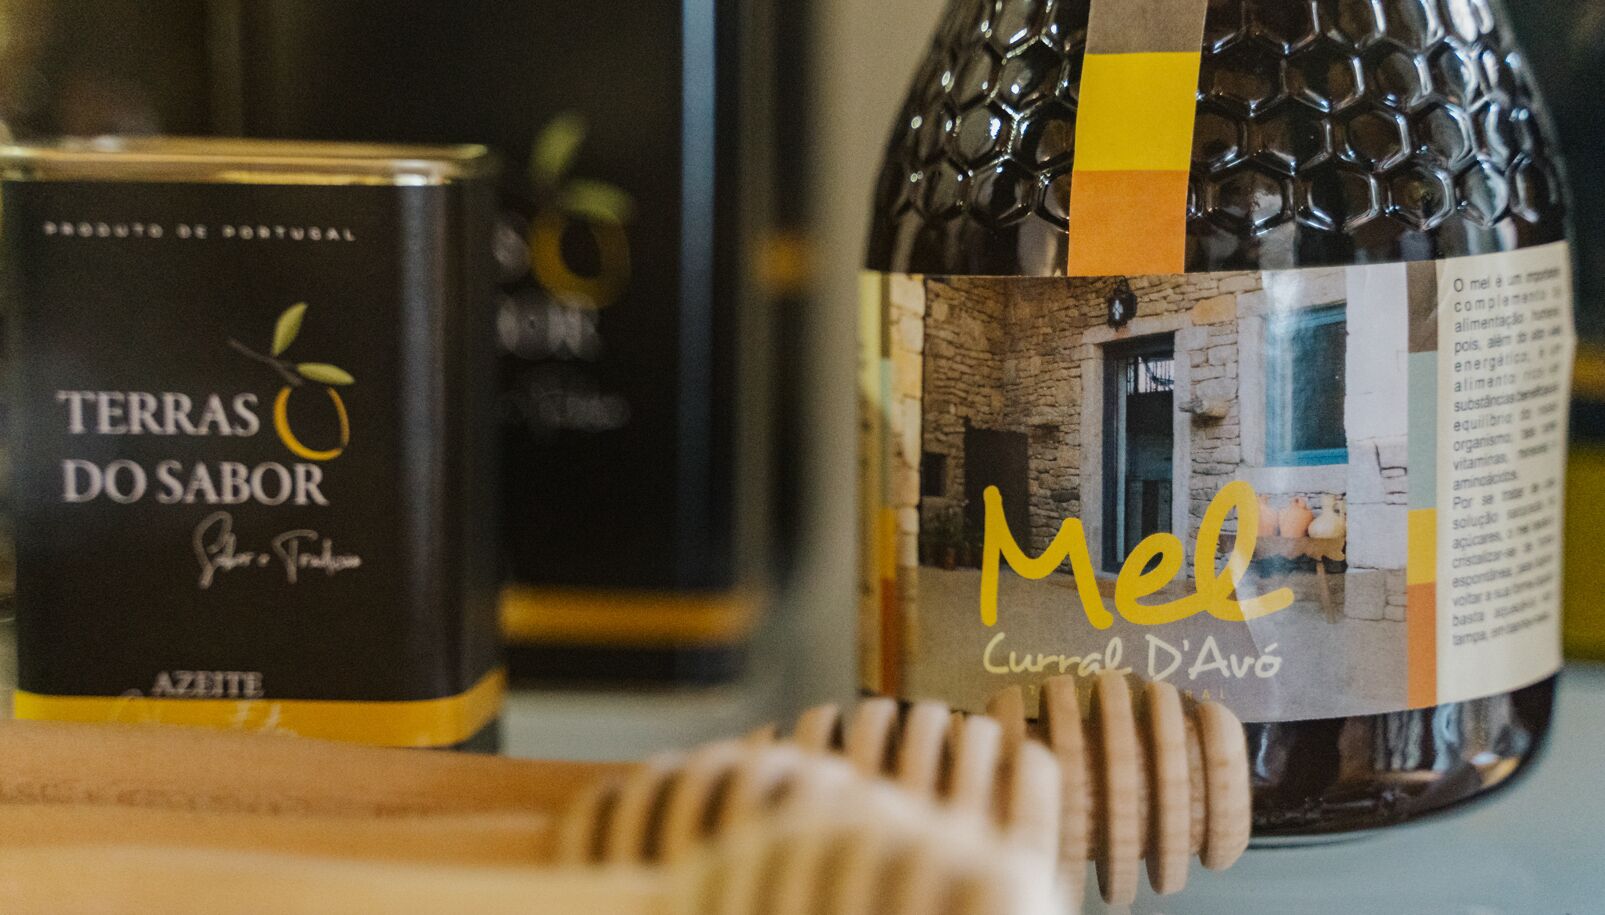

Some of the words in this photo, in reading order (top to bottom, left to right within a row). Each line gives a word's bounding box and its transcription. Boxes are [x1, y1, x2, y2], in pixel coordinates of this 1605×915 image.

[43, 220, 164, 239] PRODUTO
[176, 223, 208, 240] DE
[221, 223, 357, 242] PORTUGAL
[1453, 278, 1464, 293] O
[1470, 277, 1490, 291] mel
[1495, 274, 1503, 288] é
[1454, 312, 1525, 333] alimentação
[1454, 373, 1517, 393] alimento
[56, 390, 260, 437] TERRAS
[61, 458, 148, 504] DO
[154, 459, 330, 506] SABOR
[1452, 495, 1473, 510] Por
[980, 480, 1295, 630] Mel
[983, 631, 1133, 676] Curral
[1144, 633, 1283, 681] D'Avó
[152, 670, 265, 698] AZEITE
